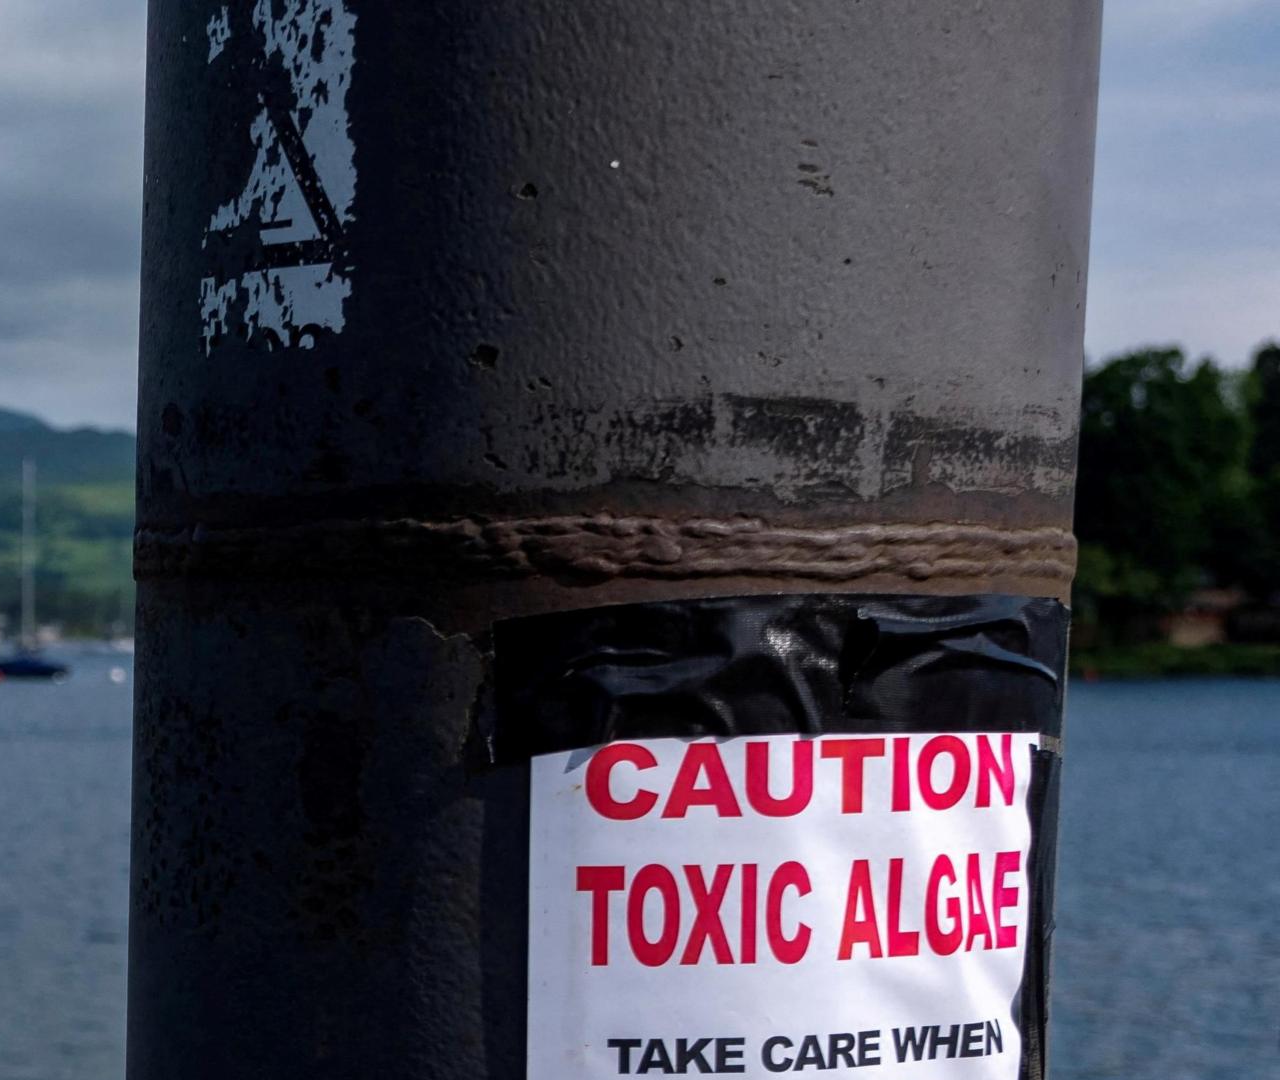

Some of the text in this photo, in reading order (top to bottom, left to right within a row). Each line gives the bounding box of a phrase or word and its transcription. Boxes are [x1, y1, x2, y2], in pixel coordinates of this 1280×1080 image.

[585, 734, 1015, 820] CAUTION
[576, 851, 1020, 967] TOXIC ALGAE
[607, 1019, 1002, 1074] TAKE CARE WHEN
